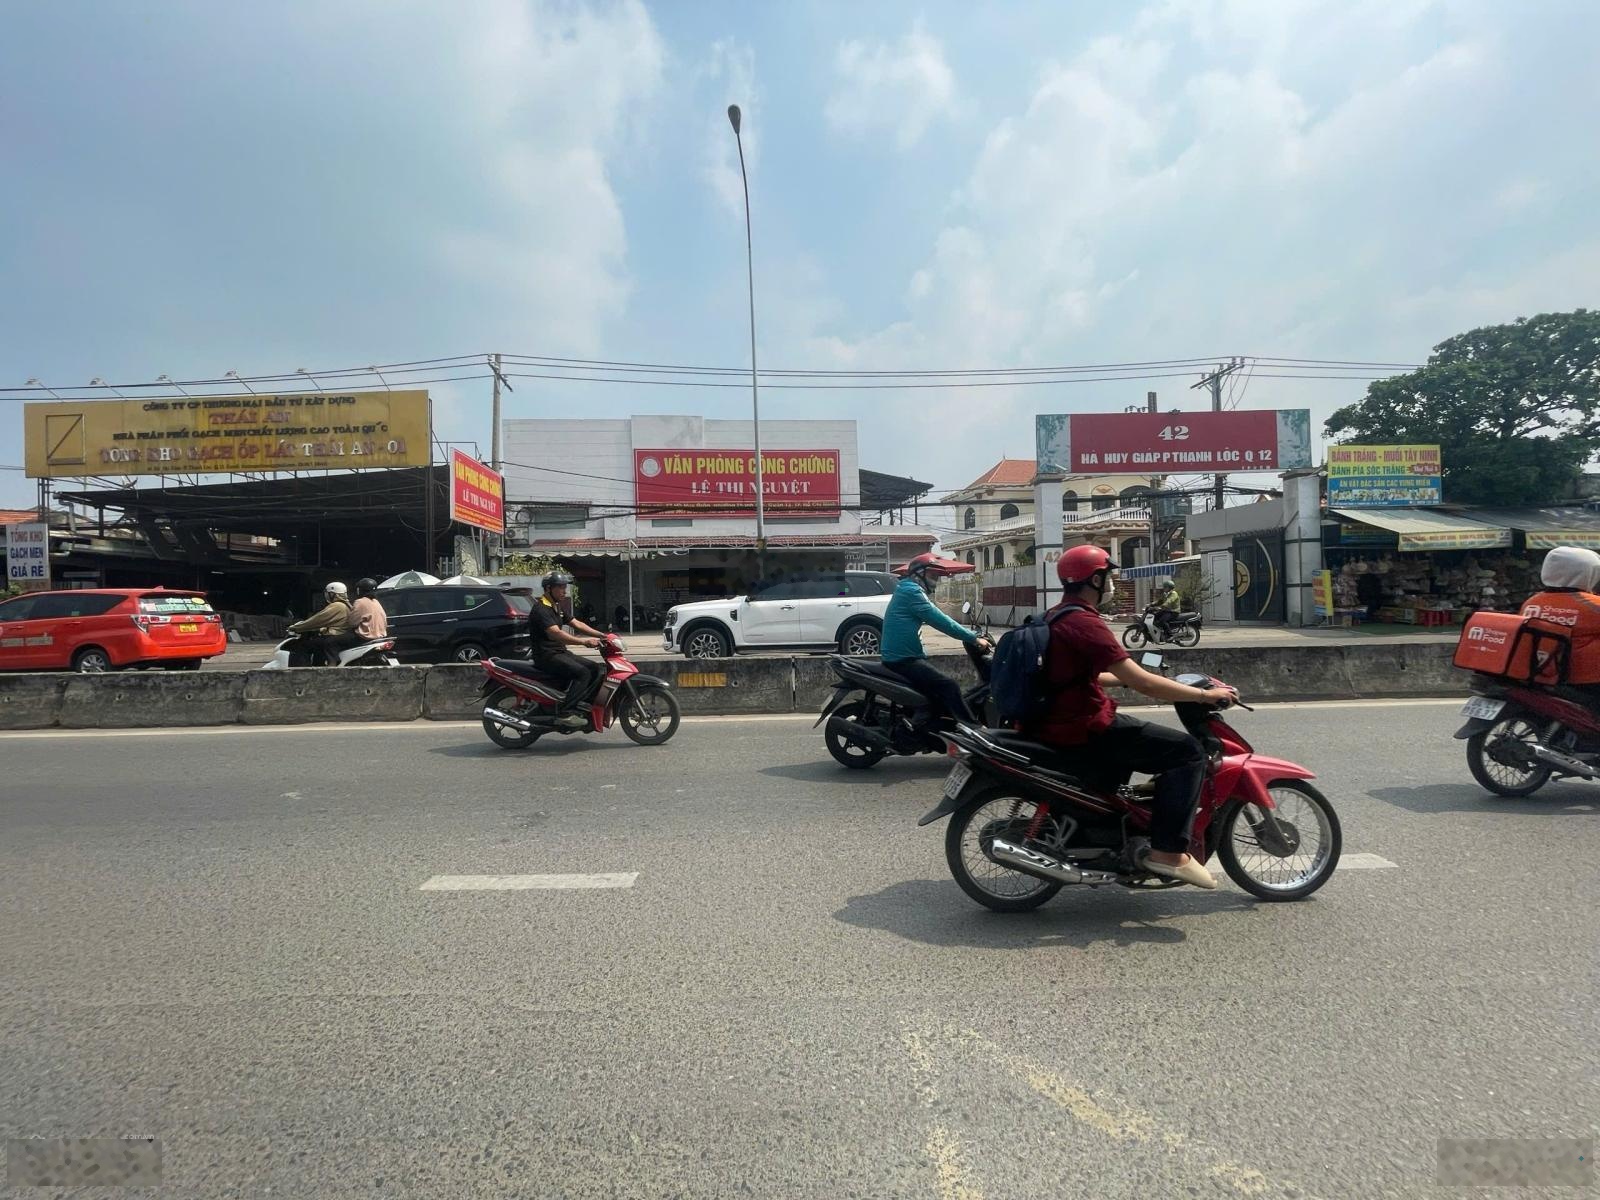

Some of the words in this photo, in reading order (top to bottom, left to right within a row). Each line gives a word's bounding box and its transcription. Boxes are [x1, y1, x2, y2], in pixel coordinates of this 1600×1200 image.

[310, 426, 330, 435] CAO
[1158, 425, 1190, 441] 42
[1104, 452, 1129, 464] HUY
[1132, 447, 1161, 463] GIÁP
[1244, 450, 1254, 462] Q
[1257, 448, 1272, 461] 12
[664, 454, 693, 474] VĂN
[697, 453, 745, 474] PHÒNG
[789, 454, 836, 475] CHỨNG
[692, 479, 711, 494] LÊ
[716, 481, 744, 496] THỊ
[10, 547, 28, 562] GẠCH
[29, 547, 44, 559] MEN
[11, 562, 28, 577] GIÁ
[1543, 605, 1579, 615] Shopee
[1541, 614, 1577, 627] Food
[1482, 634, 1505, 645] Food
